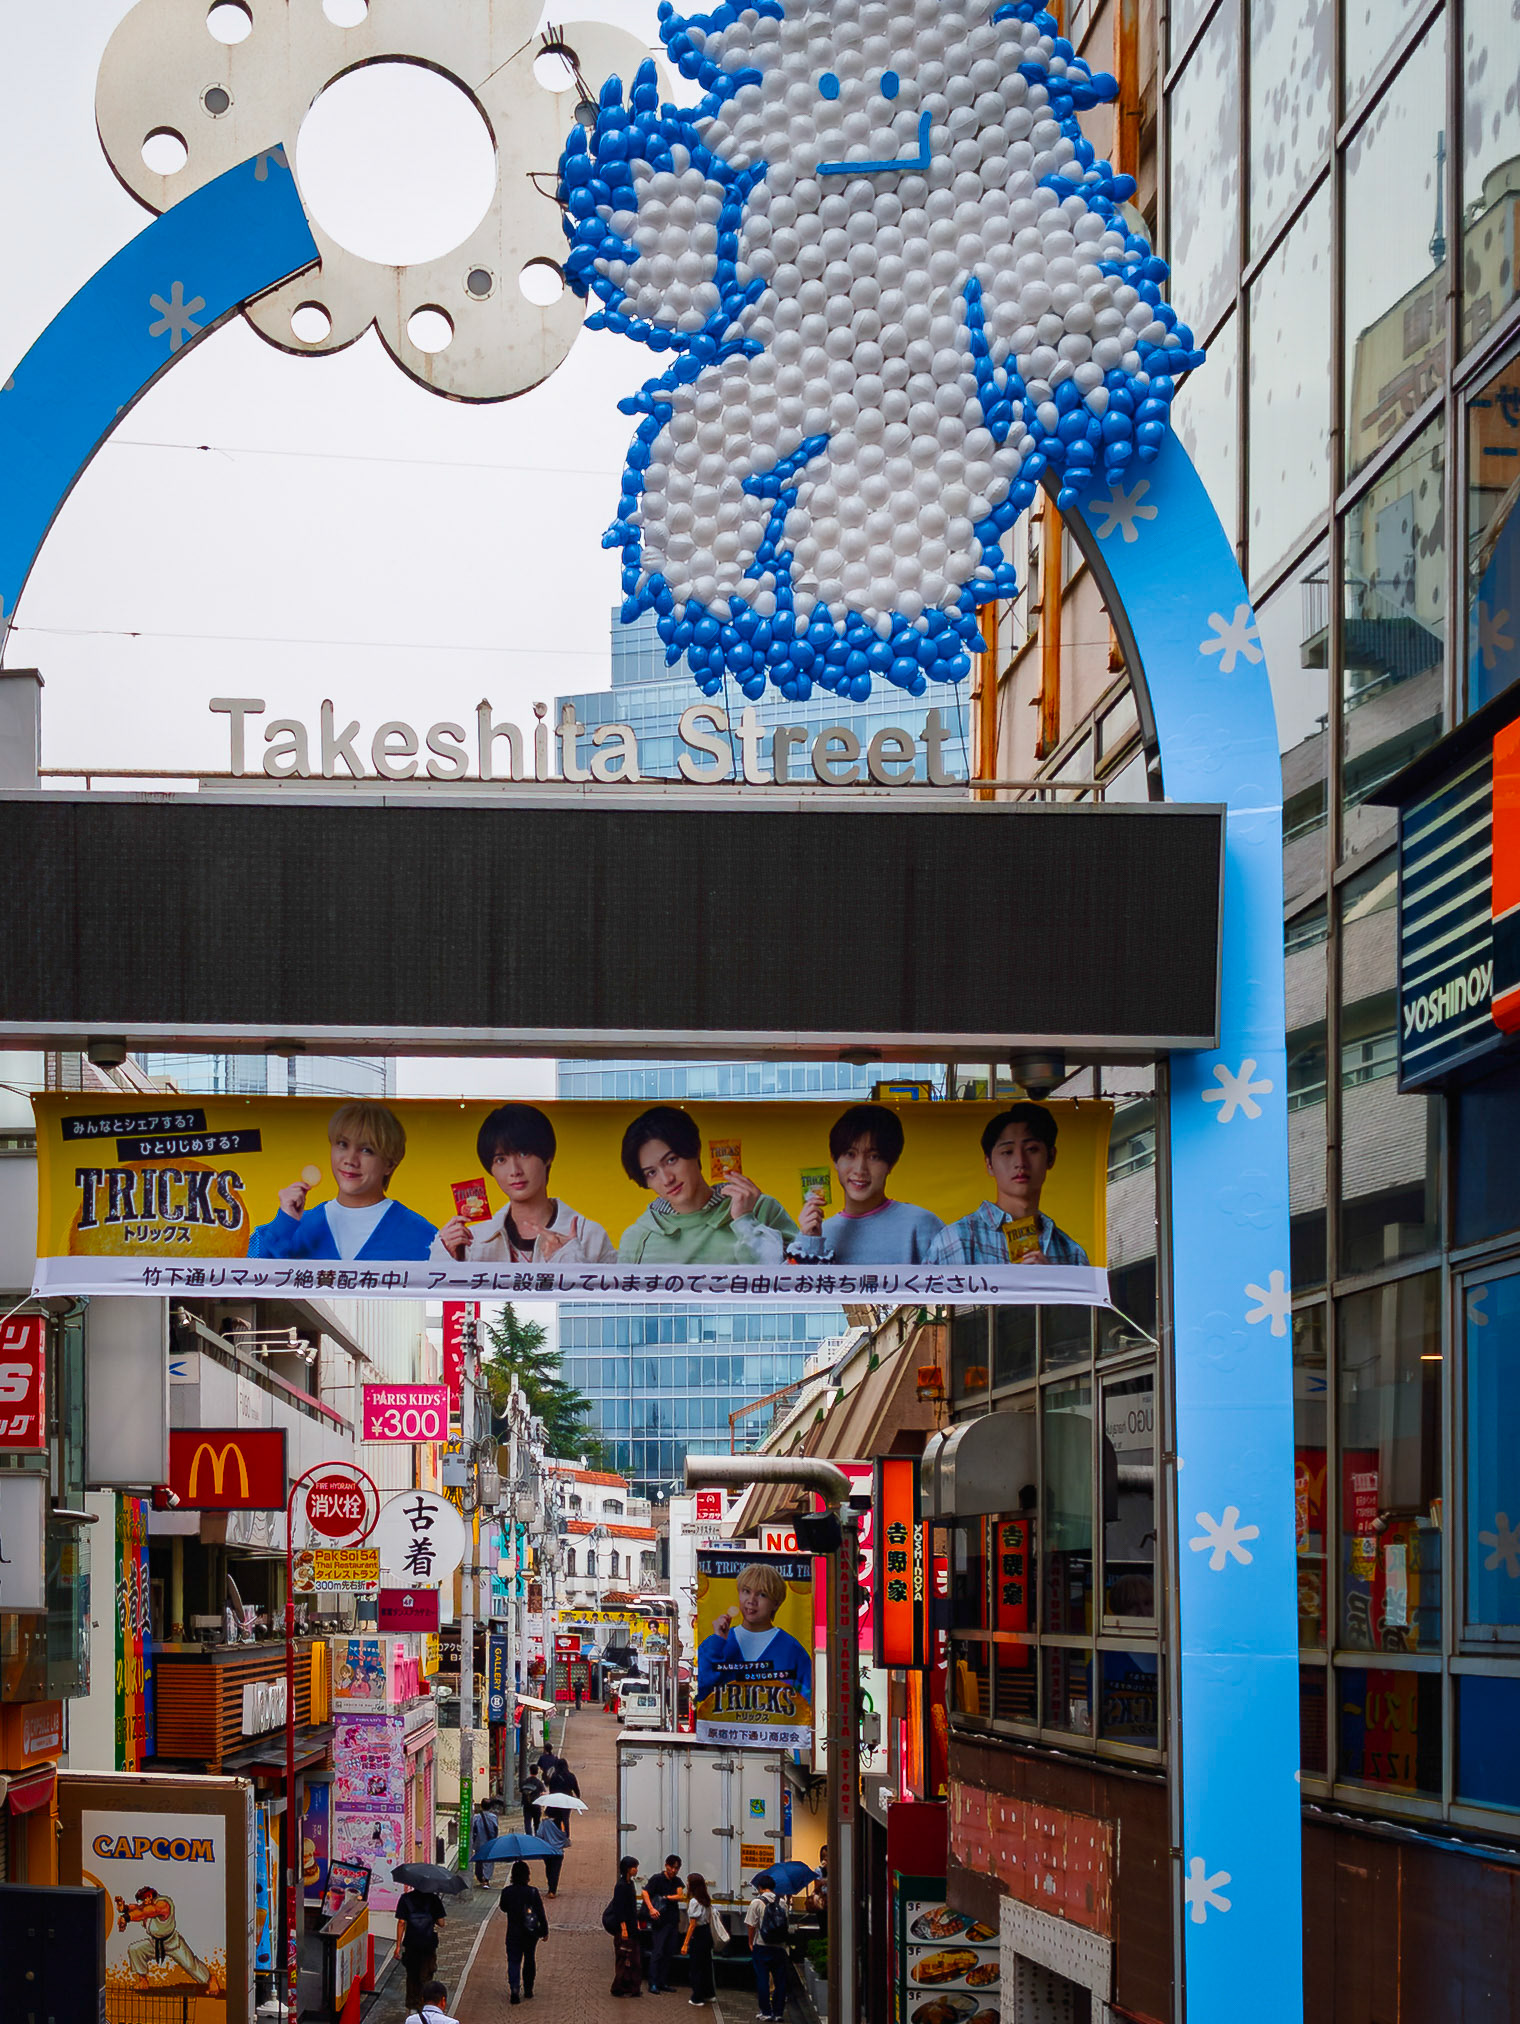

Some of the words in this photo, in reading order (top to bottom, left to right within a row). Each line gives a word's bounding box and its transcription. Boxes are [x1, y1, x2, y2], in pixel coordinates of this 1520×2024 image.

[209, 697, 640, 784] Takeshita
[677, 703, 955, 786] Street
[1403, 960, 1493, 1040] YOSHINOY
[73, 1114, 195, 1134] みんなとシェアする?
[140, 1136, 240, 1155] ひとりじめする?
[75, 1167, 246, 1231] TRICKS
[124, 1225, 192, 1244] トリックス
[142, 1266, 408, 1290] 竹下通りマップ絶賛配布中!
[427, 1271, 1000, 1295] アーチに設置していますのでご自由にお持ち帰りください。
[372, 1390, 408, 1406] PARIS
[409, 1393, 441, 1406] KID'S
[370, 1409, 440, 1437] ¥300
[311, 1494, 362, 1519] 消火栓
[402, 1496, 438, 1577] 古着
[315, 1561, 333, 1569] Thai
[886, 1521, 908, 1603] 吉野家
[913, 1524, 923, 1601] YOSHINOYA
[315, 1570, 378, 1580] タイレストラン
[315, 1580, 366, 1591] 300m先右折
[494, 1647, 503, 1691] GALLERY
[712, 1682, 797, 1717] TRICKS
[735, 1713, 770, 1722] トリックス
[708, 1728, 800, 1743] 原宿竹下通り商店会
[93, 1834, 216, 1862] CAPCOM
[908, 1903, 921, 1911] 3F
[908, 1947, 921, 1956] 3F
[908, 1992, 921, 2000] 3F
